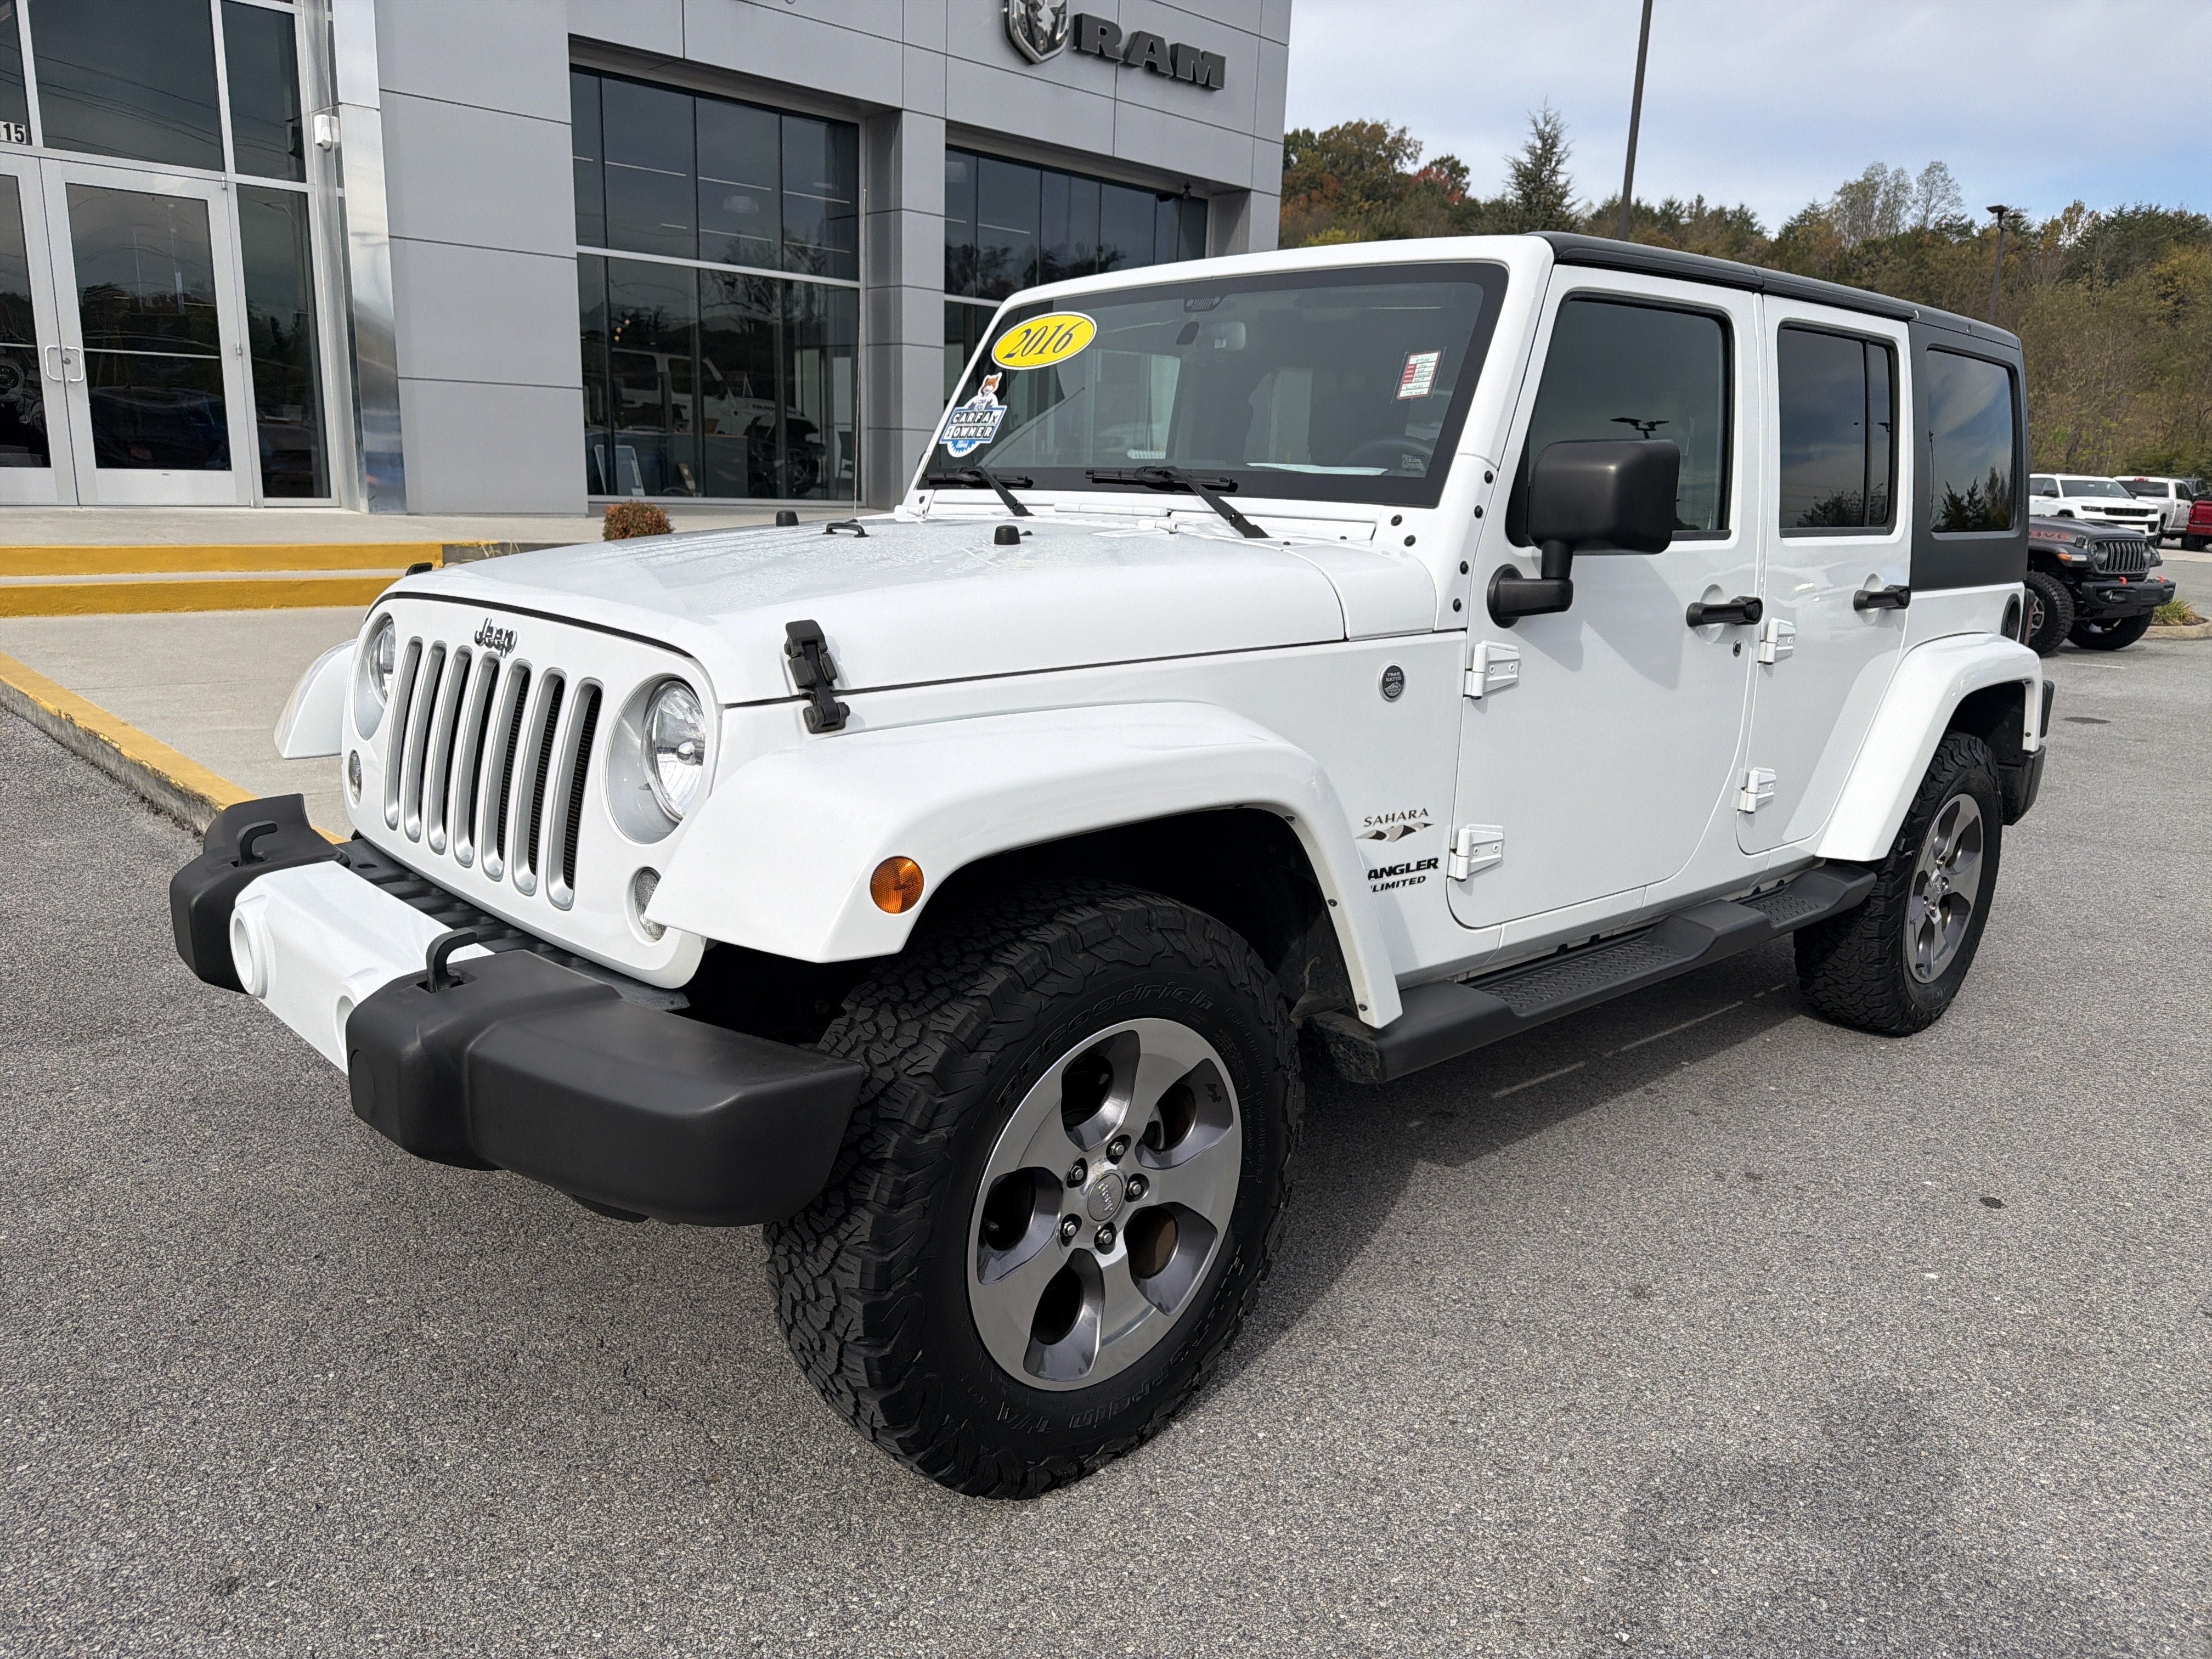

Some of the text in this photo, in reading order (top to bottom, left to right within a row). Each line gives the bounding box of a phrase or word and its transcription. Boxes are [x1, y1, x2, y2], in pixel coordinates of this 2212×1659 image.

[1074, 13, 1226, 89] RAM
[3, 122, 25, 143] 15
[1002, 320, 1085, 359] 2016
[952, 411, 998, 424] CARFAX
[475, 617, 517, 658] Jeep
[1364, 808, 1430, 827] SAHARA
[1367, 857, 1439, 881] ANGLER
[1370, 876, 1426, 893] LIMITED
[996, 980, 1216, 1114] BFGoodrich
